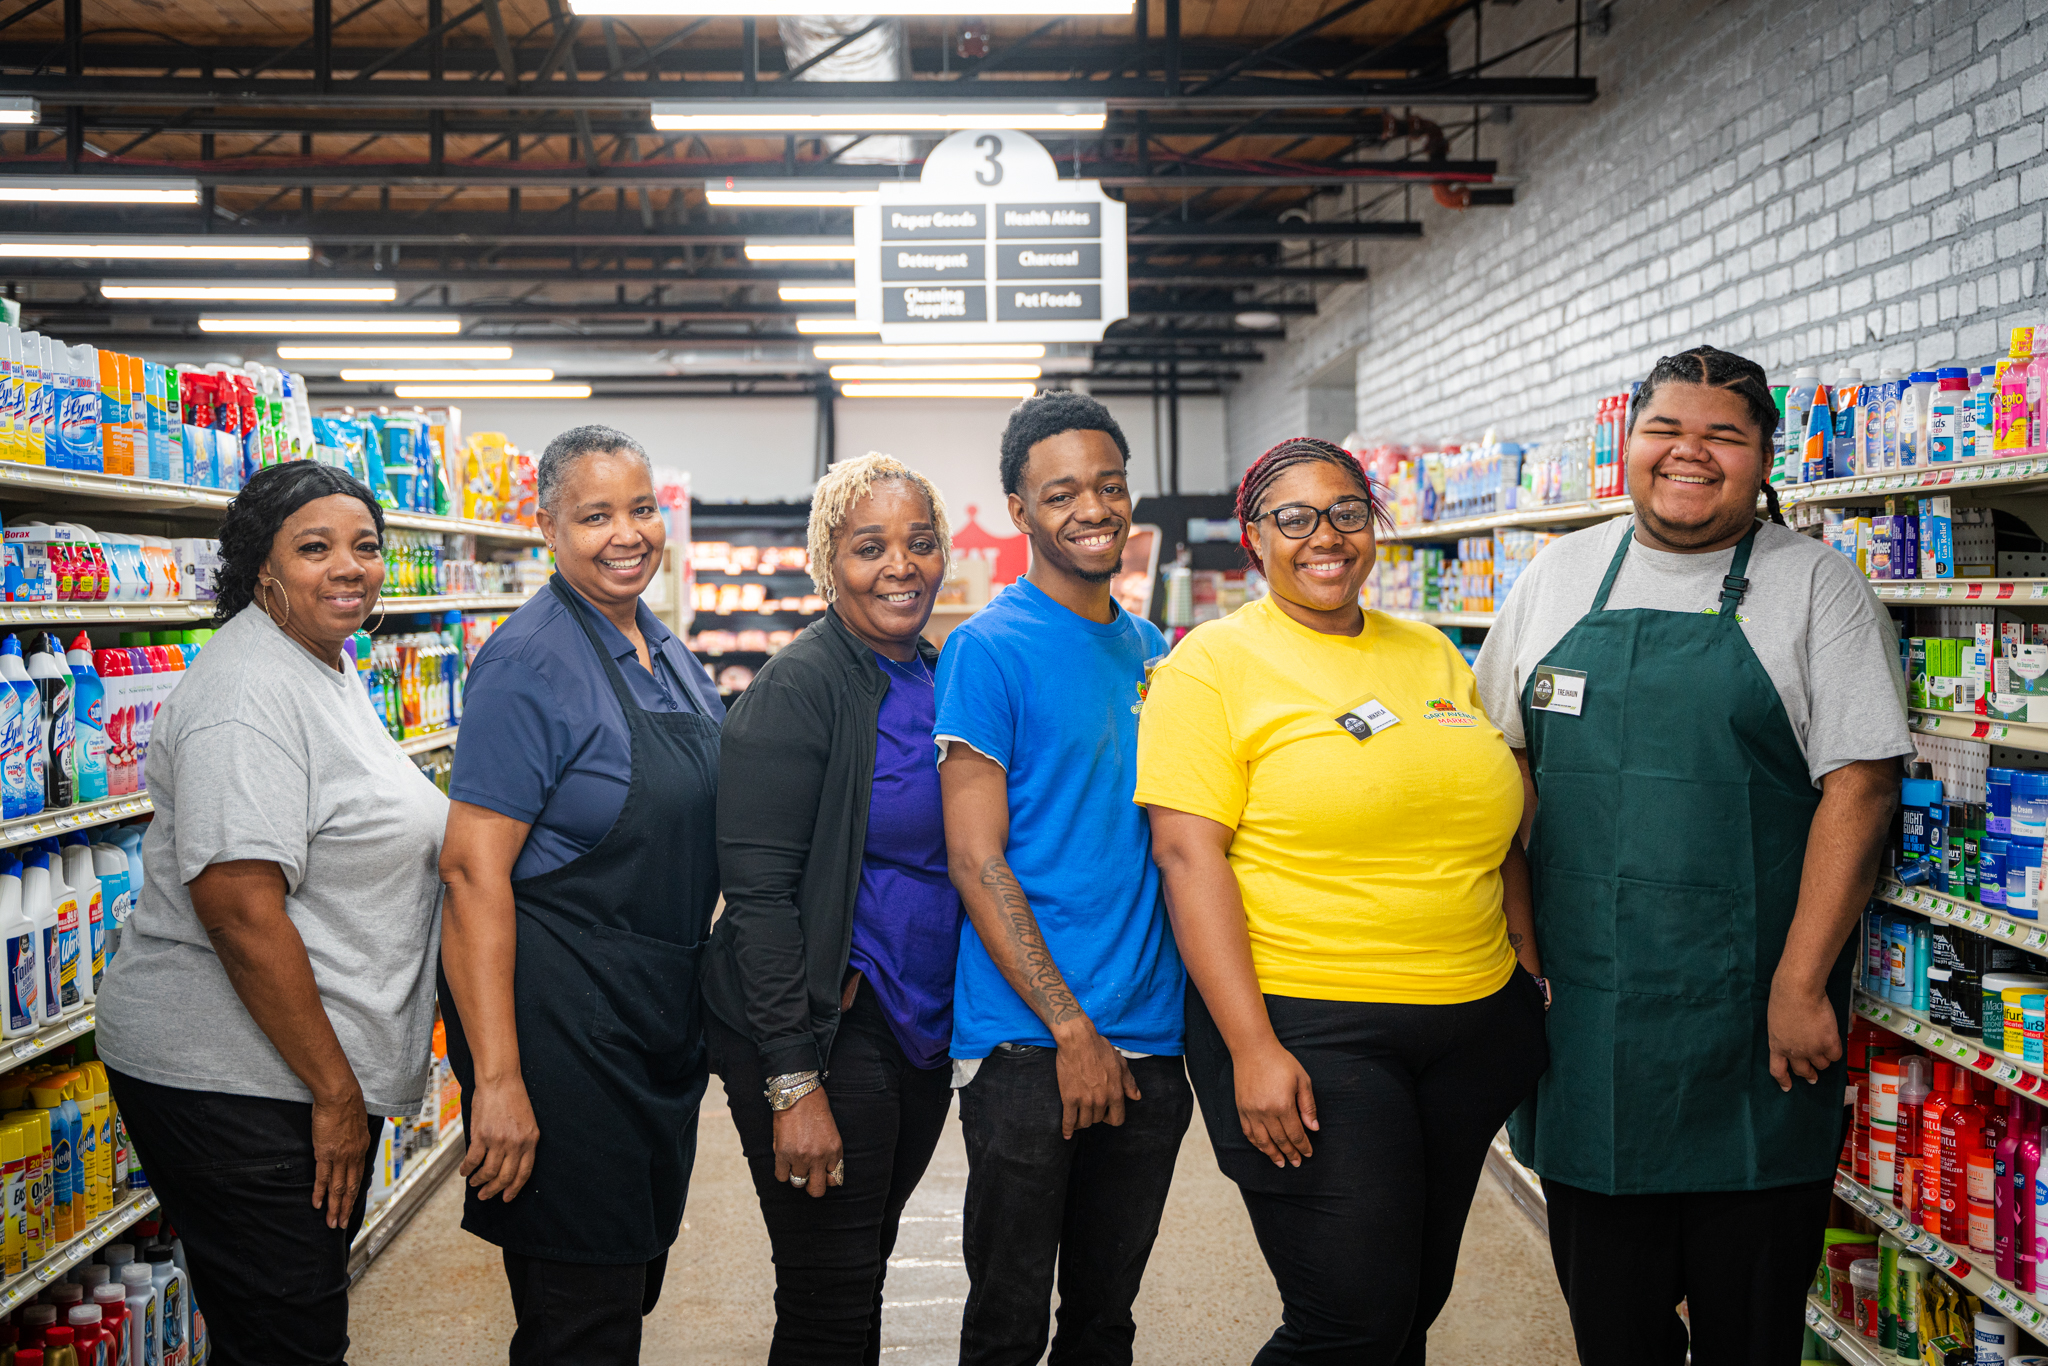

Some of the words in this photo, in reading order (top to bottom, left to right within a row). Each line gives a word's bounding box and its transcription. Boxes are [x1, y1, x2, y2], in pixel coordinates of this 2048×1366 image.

[974, 134, 1004, 187] 3
[891, 212, 932, 232] Paper
[932, 210, 977, 228] Goods
[1004, 210, 1051, 226] Health
[1051, 210, 1090, 226] Aides
[898, 252, 969, 271] Detergent
[1018, 250, 1079, 267] Charcoal
[904, 287, 966, 304] Cleaning
[1014, 292, 1040, 308] Pet
[1040, 291, 1082, 308] Foods
[906, 302, 966, 320] Supplies
[76, 378, 92, 388] 100
[4, 530, 30, 539] Borax
[1940, 522, 1948, 544] Relief
[1424, 712, 1446, 720] GARY
[1447, 711, 1479, 720] AVENUE
[1904, 811, 1924, 824] RIGHT
[1903, 823, 1924, 835] GUARD
[1965, 842, 1977, 852] BRUT
[12, 951, 35, 985] Toilet
